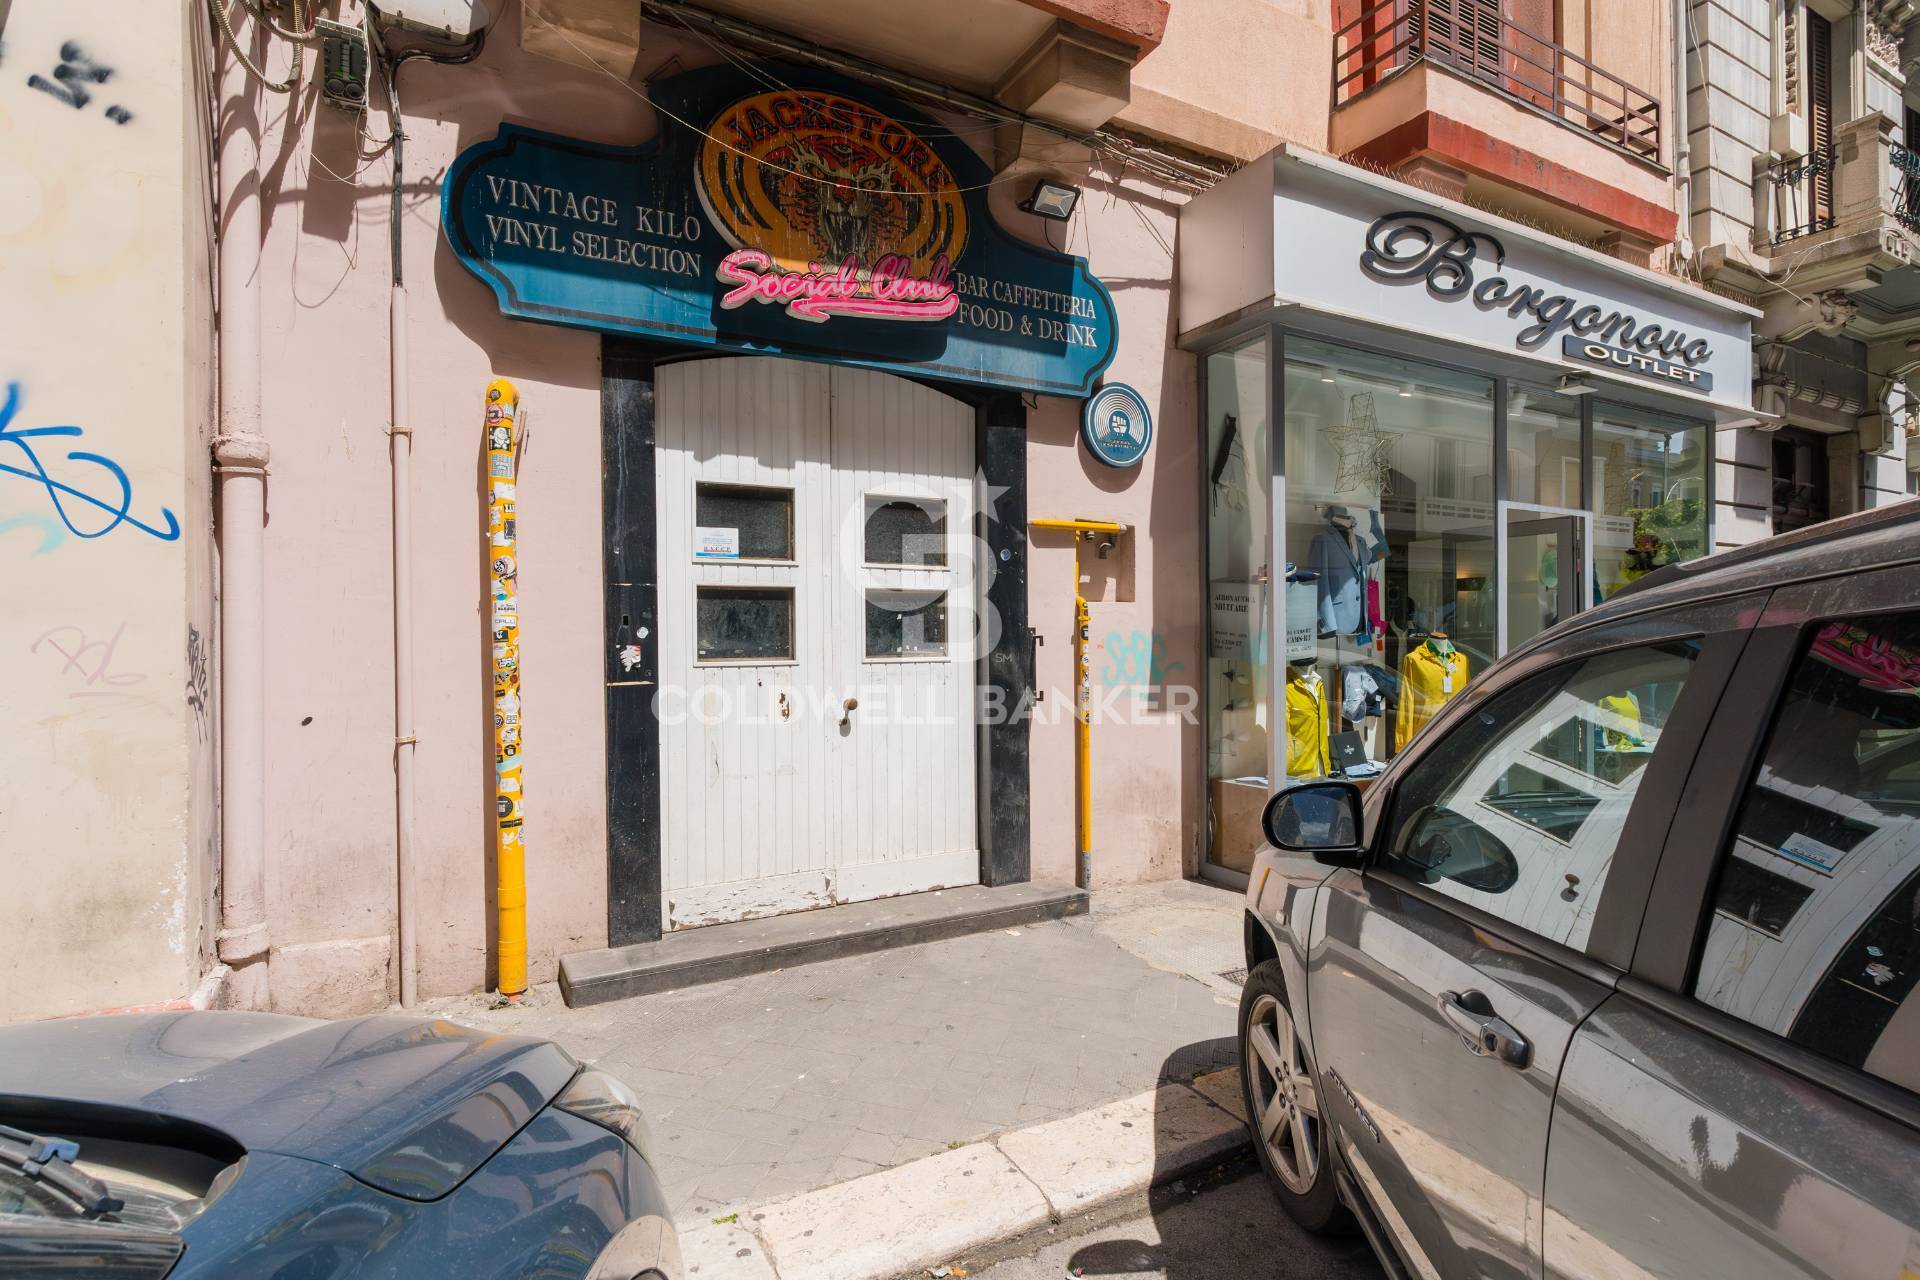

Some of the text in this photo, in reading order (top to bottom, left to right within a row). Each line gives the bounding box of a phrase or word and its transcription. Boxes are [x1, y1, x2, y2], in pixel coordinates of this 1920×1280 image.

[727, 97, 953, 191] JACKSTORE
[486, 174, 701, 242] VINTAGE KILO
[485, 213, 702, 278] VINYL SELECTION
[717, 249, 955, 308] Social Club
[956, 272, 1097, 320] BAR CAFFETTERIA
[1360, 211, 1713, 368] Borgonovo
[957, 302, 1098, 349] FOOD & DRINK
[1584, 344, 1702, 383] OUTLET
